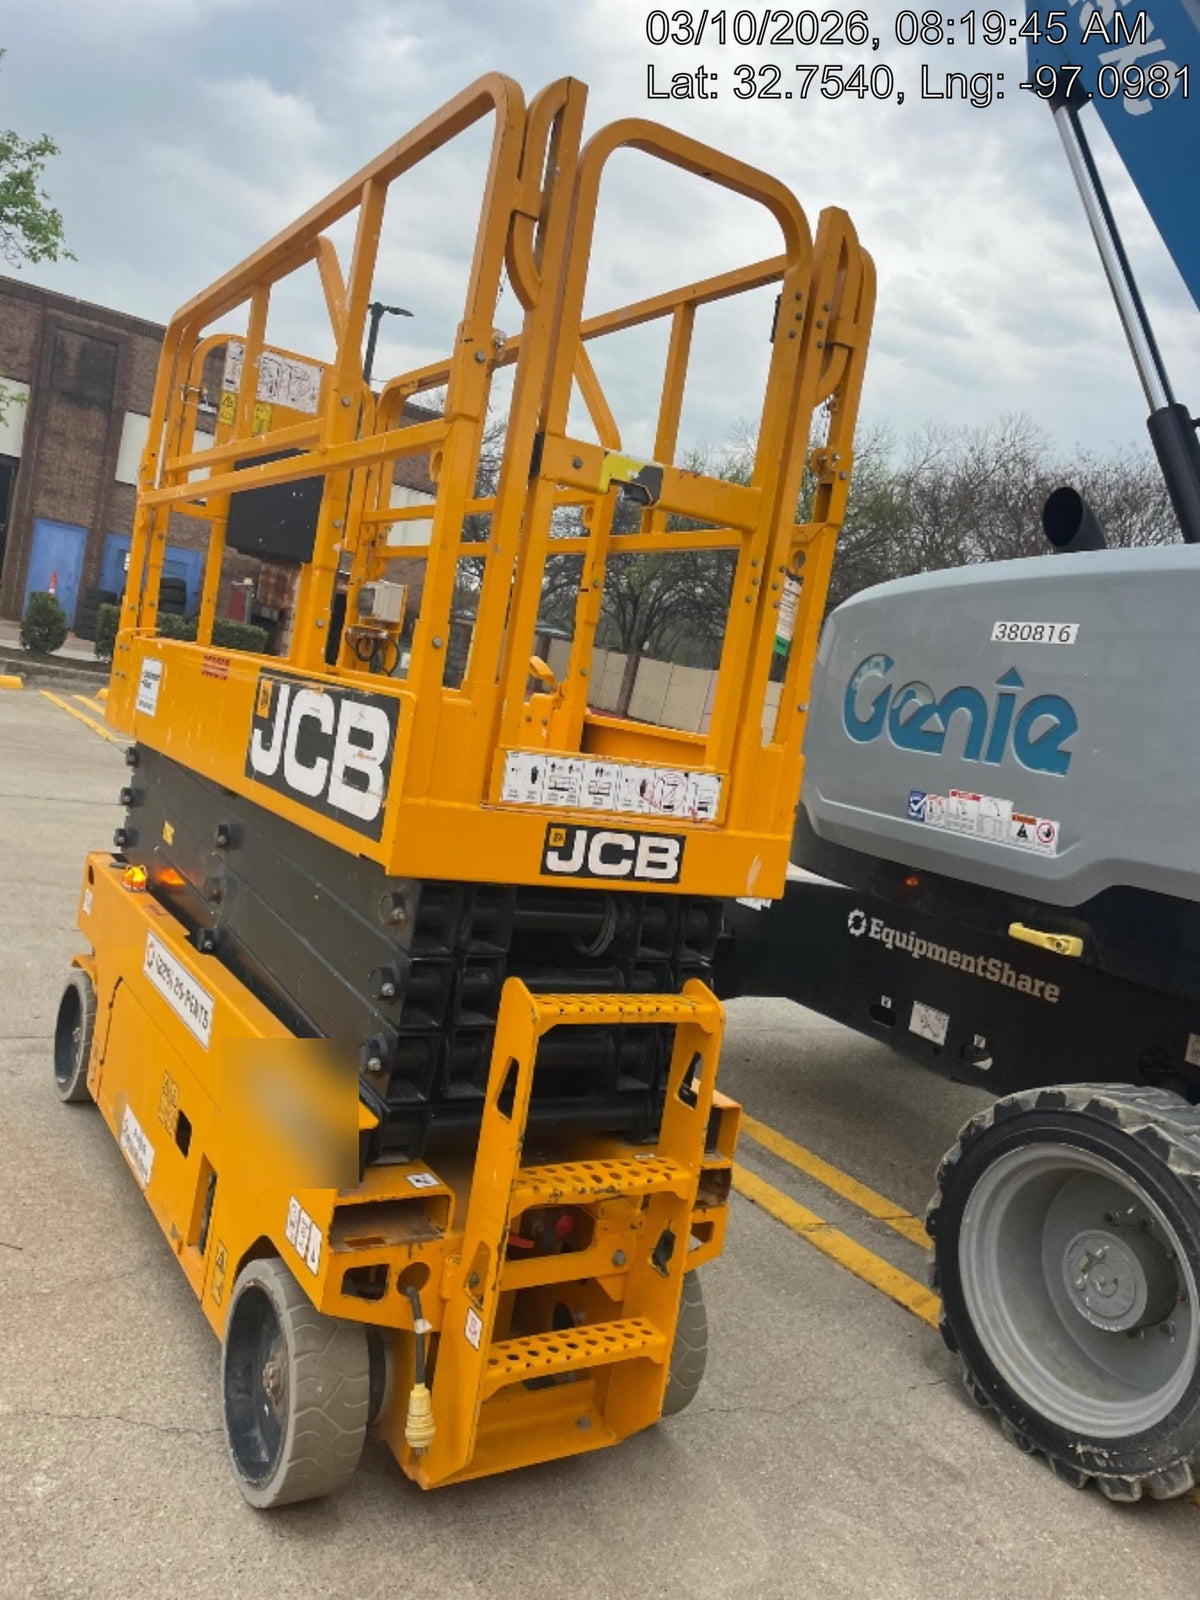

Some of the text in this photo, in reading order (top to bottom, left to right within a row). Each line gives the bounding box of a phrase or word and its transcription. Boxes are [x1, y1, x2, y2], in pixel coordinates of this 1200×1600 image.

[995, 623, 1071, 642] 380816
[251, 684, 390, 821] JCB
[842, 653, 1079, 777] Genie
[546, 829, 680, 879] JCB
[868, 917, 1061, 1004] EquipmentShare
